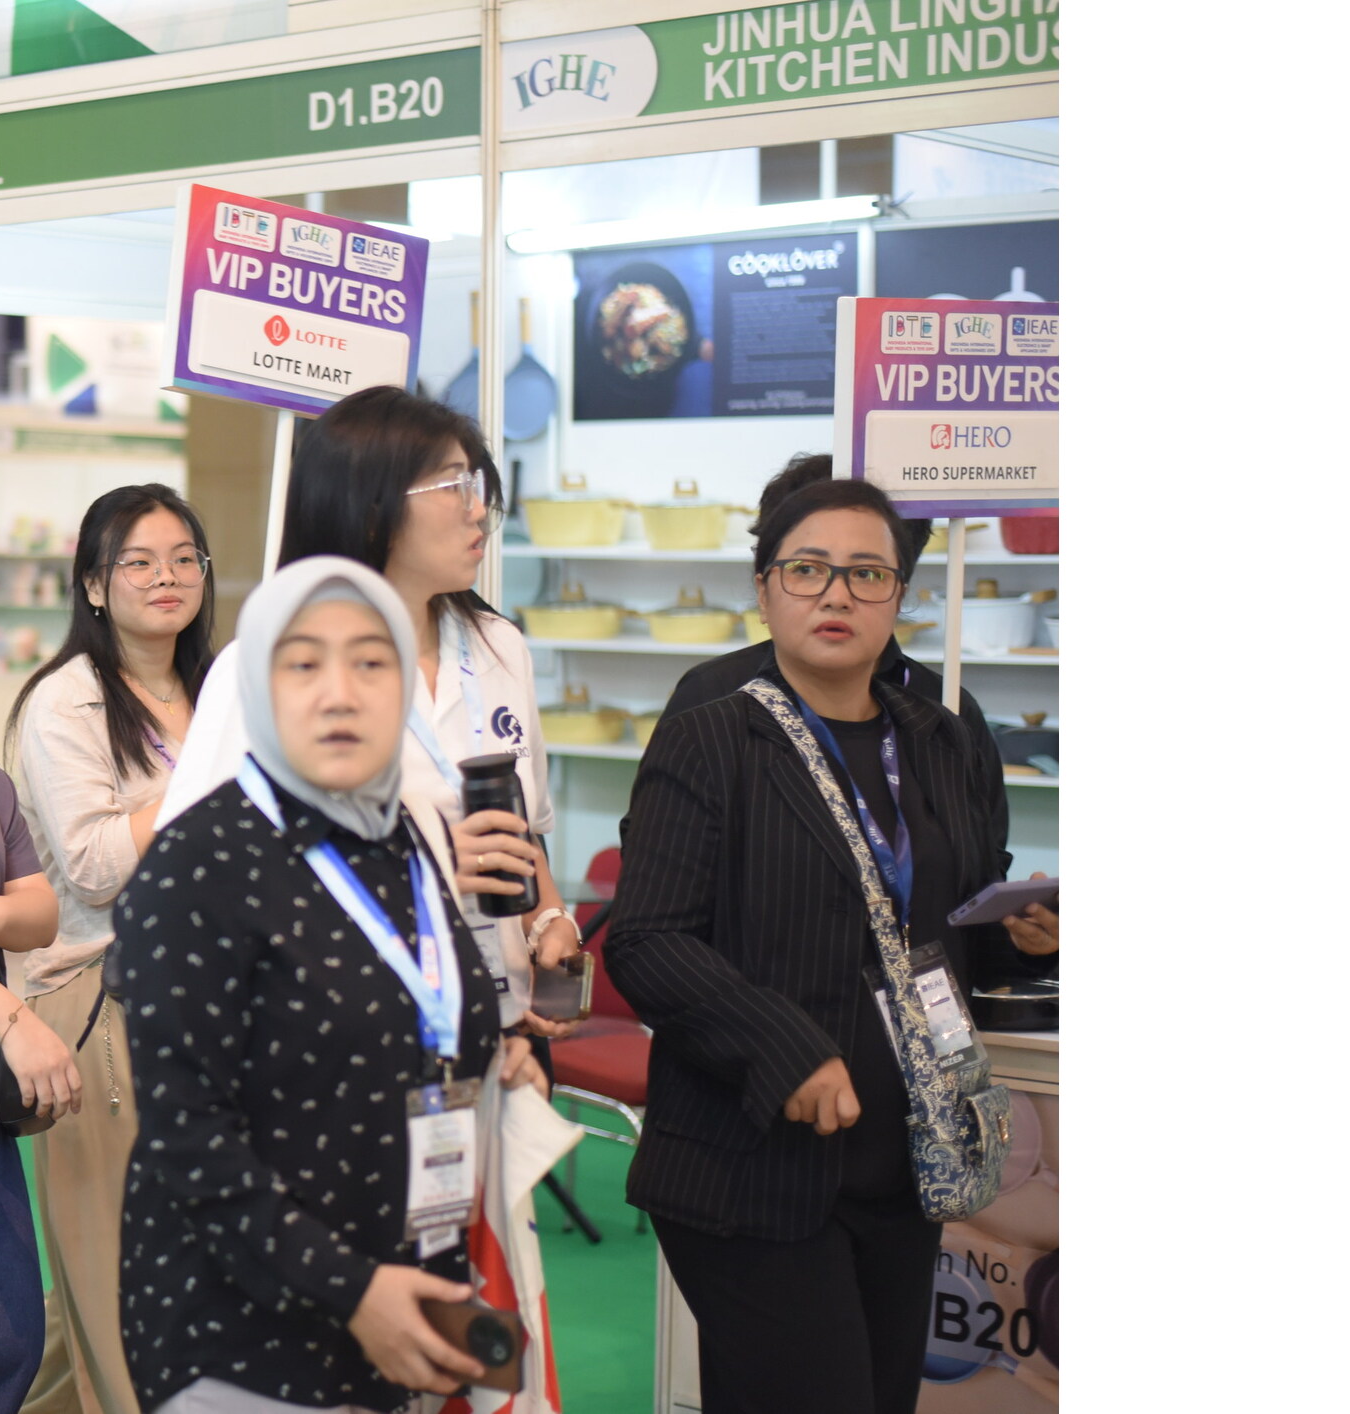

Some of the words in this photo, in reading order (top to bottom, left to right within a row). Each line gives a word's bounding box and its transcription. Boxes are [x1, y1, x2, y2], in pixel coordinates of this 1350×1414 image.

[702, 0, 877, 57] JINHUA
[704, 38, 909, 102] KITCHEN
[926, 20, 1059, 76] INDU
[510, 53, 617, 112] IGHE
[309, 76, 444, 132] D1.B20
[291, 224, 335, 251] IGHE
[366, 239, 401, 262] IEAE
[206, 247, 264, 291] VIP
[267, 262, 407, 325] BUYERS
[295, 329, 348, 352] LOTTE
[953, 316, 995, 340] IGHE
[1026, 319, 1059, 335] IEAE
[252, 351, 302, 376] LOTTE
[306, 363, 353, 386] MART
[874, 364, 930, 402] VIP
[954, 425, 1012, 448] HERO
[902, 466, 939, 481] HERO
[942, 466, 1037, 481] SUPERMARKET
[966, 1249, 1017, 1287] No.
[934, 1291, 1040, 1358] B20
